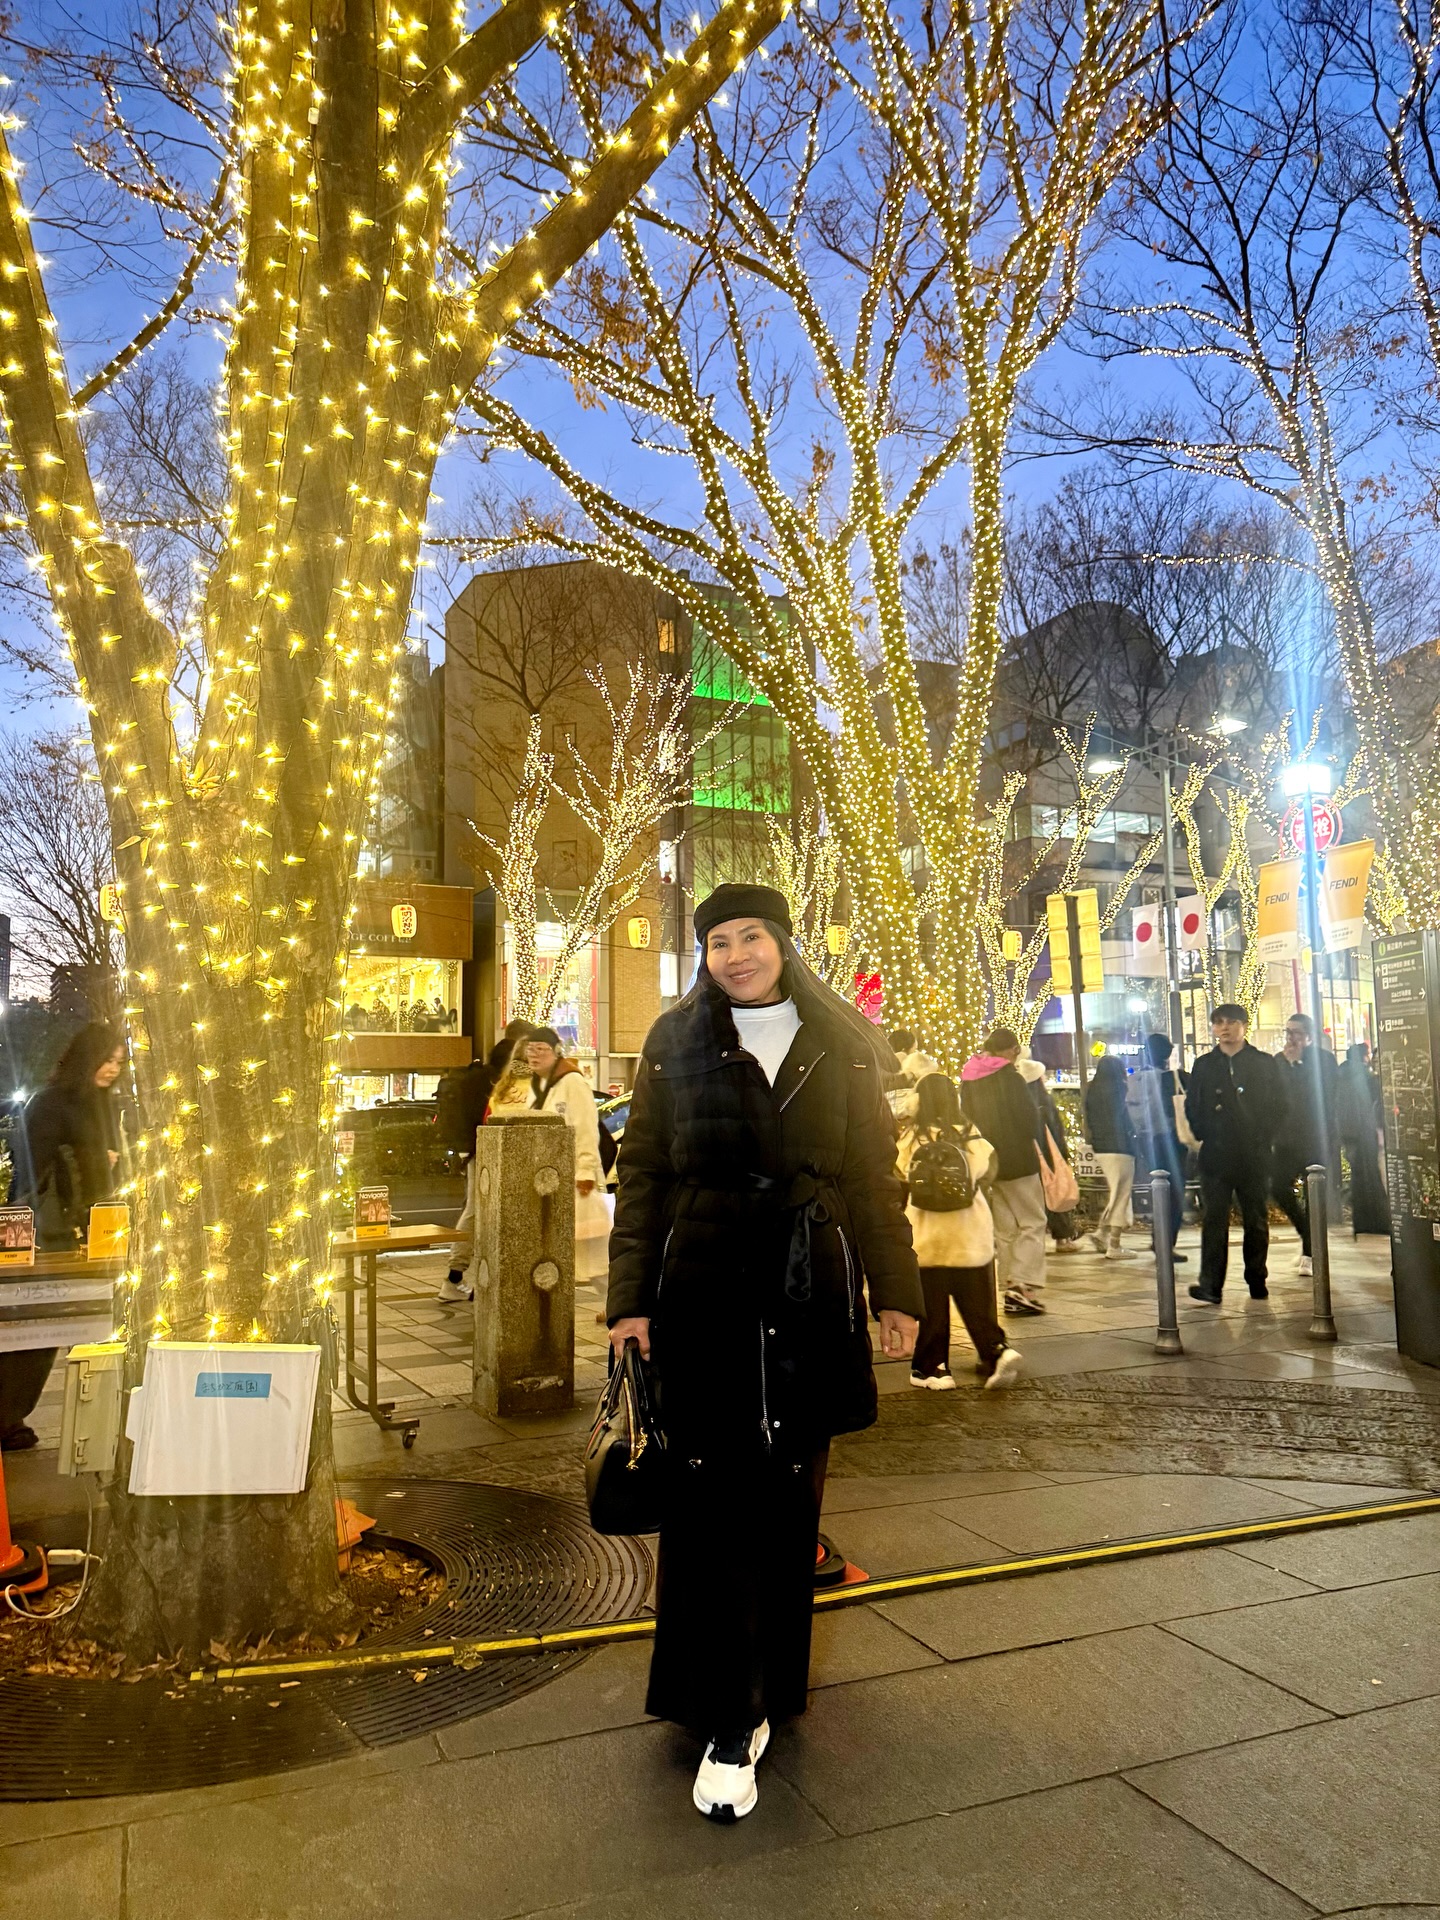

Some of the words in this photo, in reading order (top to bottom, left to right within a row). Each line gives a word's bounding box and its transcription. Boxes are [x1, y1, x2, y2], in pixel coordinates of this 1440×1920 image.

[1294, 817, 1331, 843] 消栓
[1329, 876, 1359, 891] FENDI
[1264, 892, 1290, 906] FENDI
